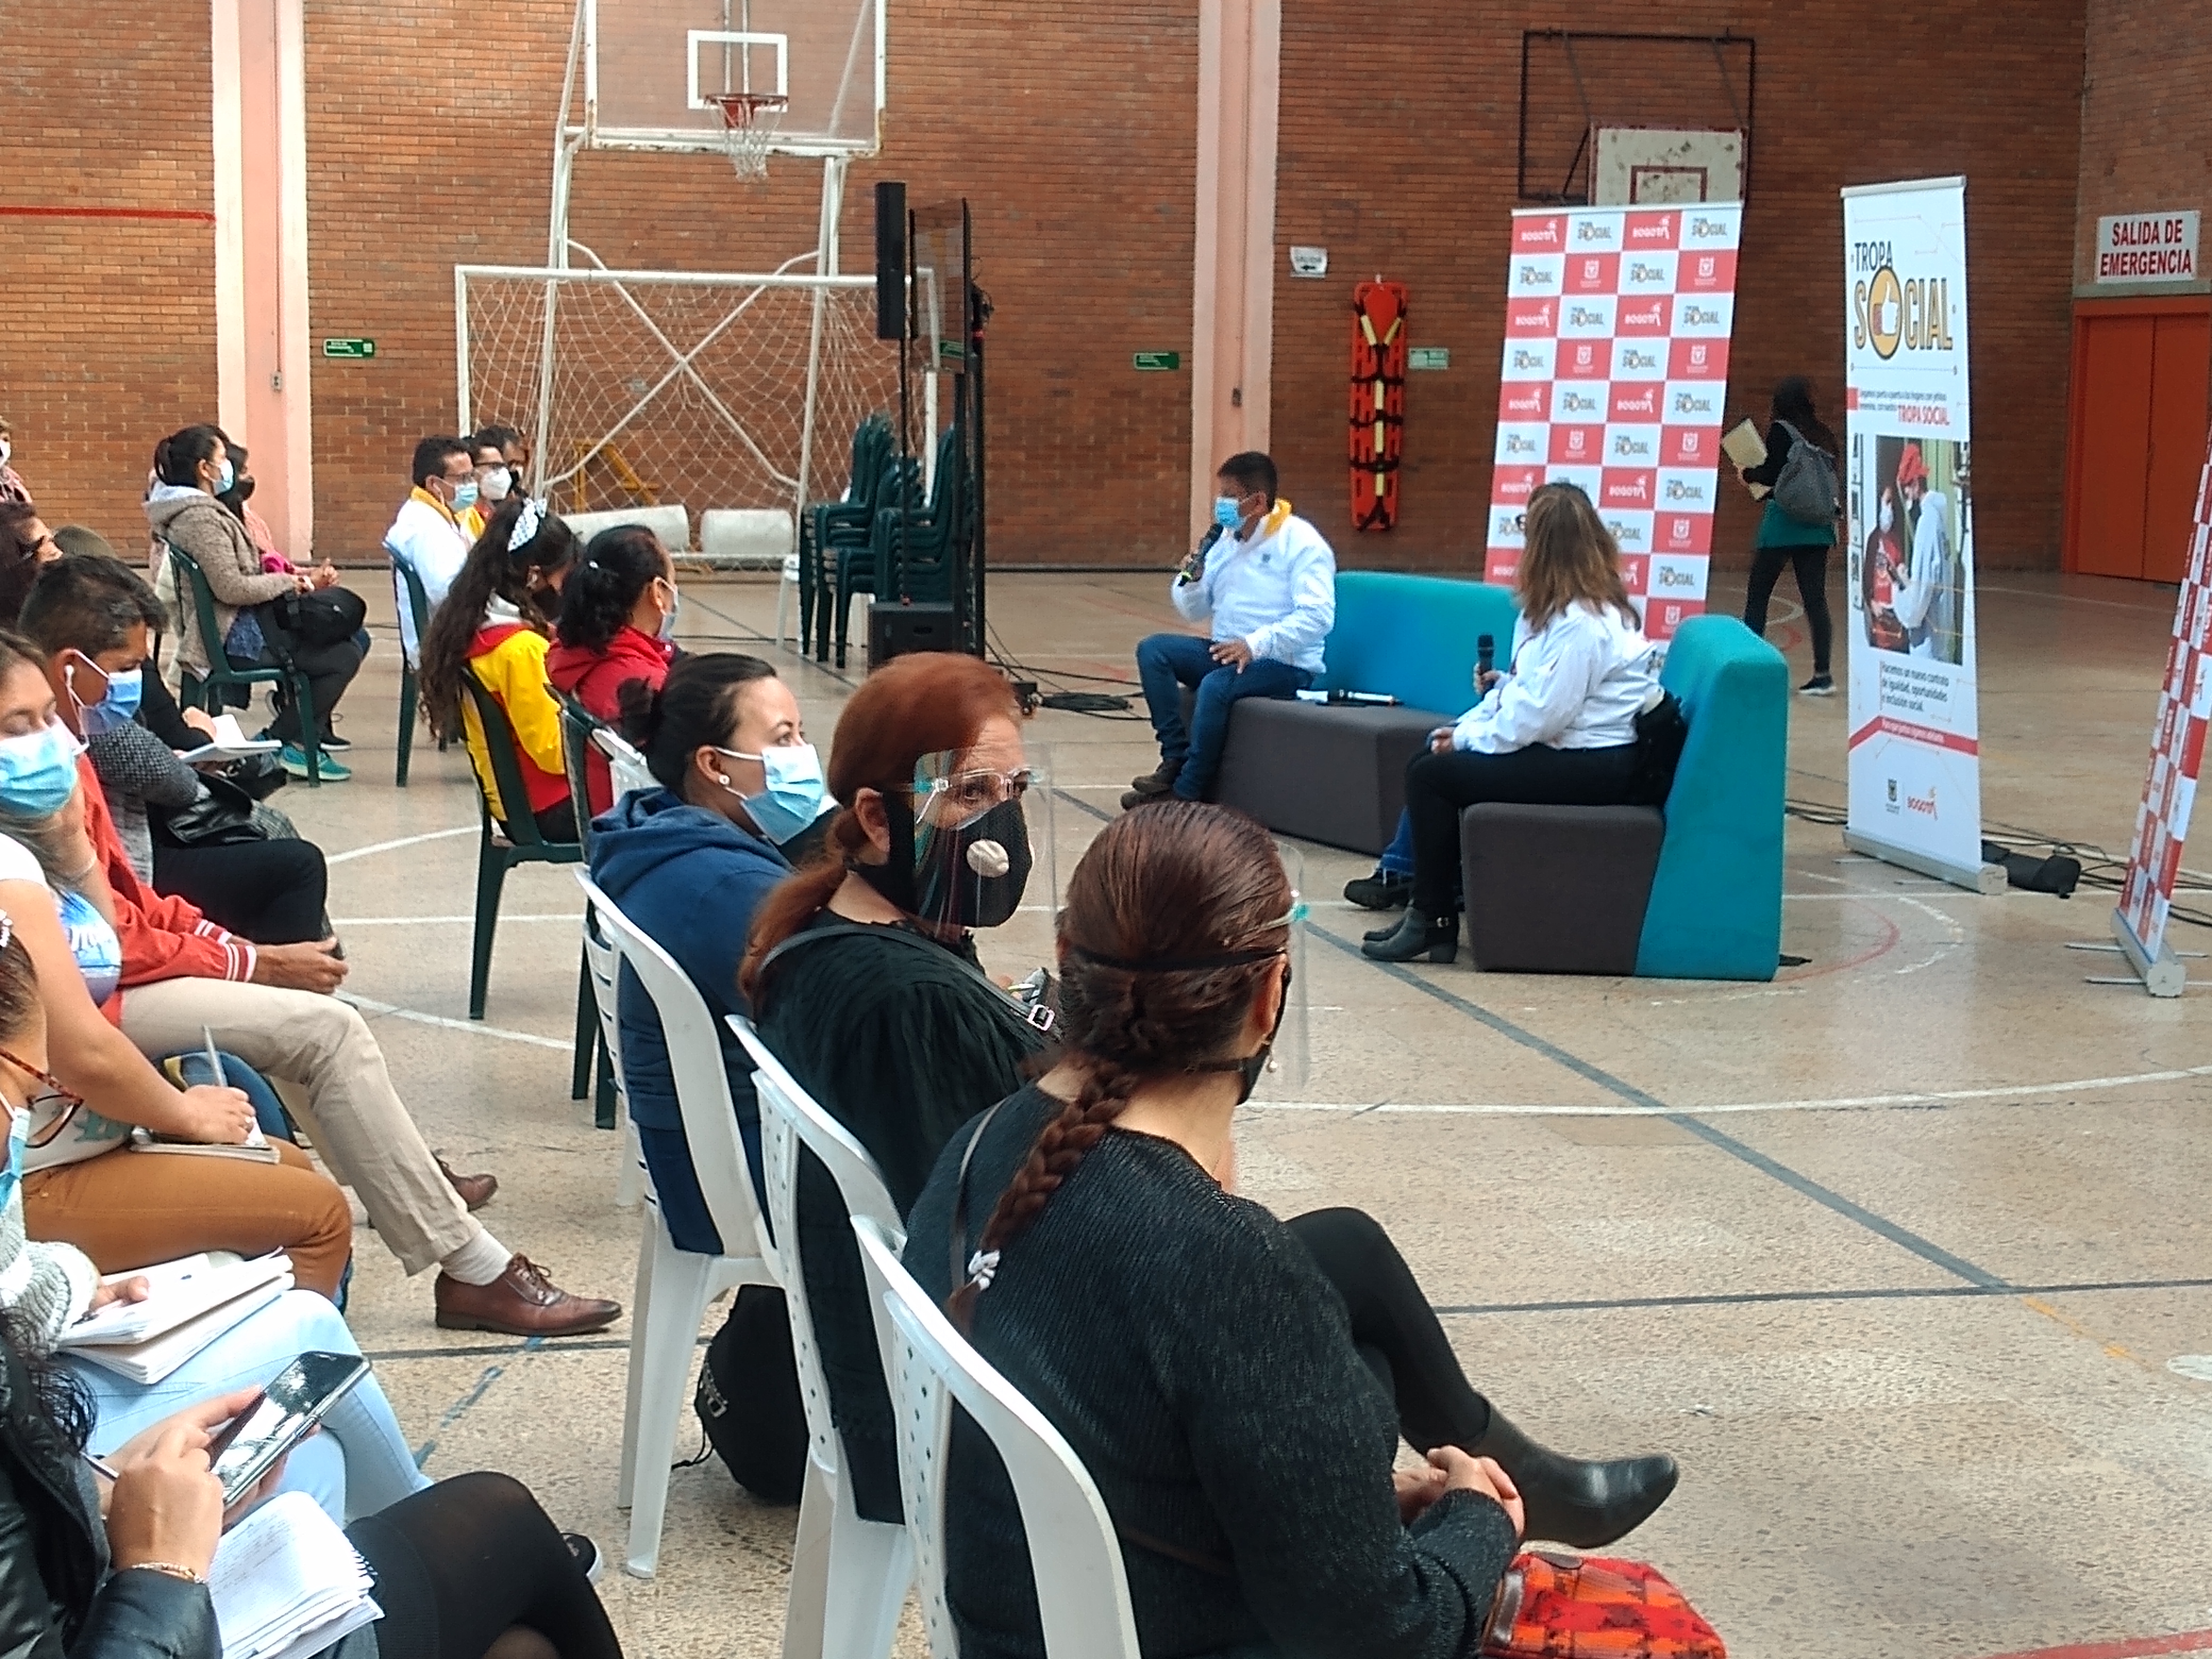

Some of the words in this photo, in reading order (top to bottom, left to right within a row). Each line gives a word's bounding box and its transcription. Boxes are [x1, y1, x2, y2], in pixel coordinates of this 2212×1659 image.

[2112, 220, 2159, 246] SALIDA
[2165, 219, 2183, 244] DE
[1854, 241, 1893, 272] TROPA
[2100, 249, 2191, 276] EMERGENCIA
[1854, 267, 1954, 359] SOCIAL
[1898, 405, 1920, 422] TROPA
